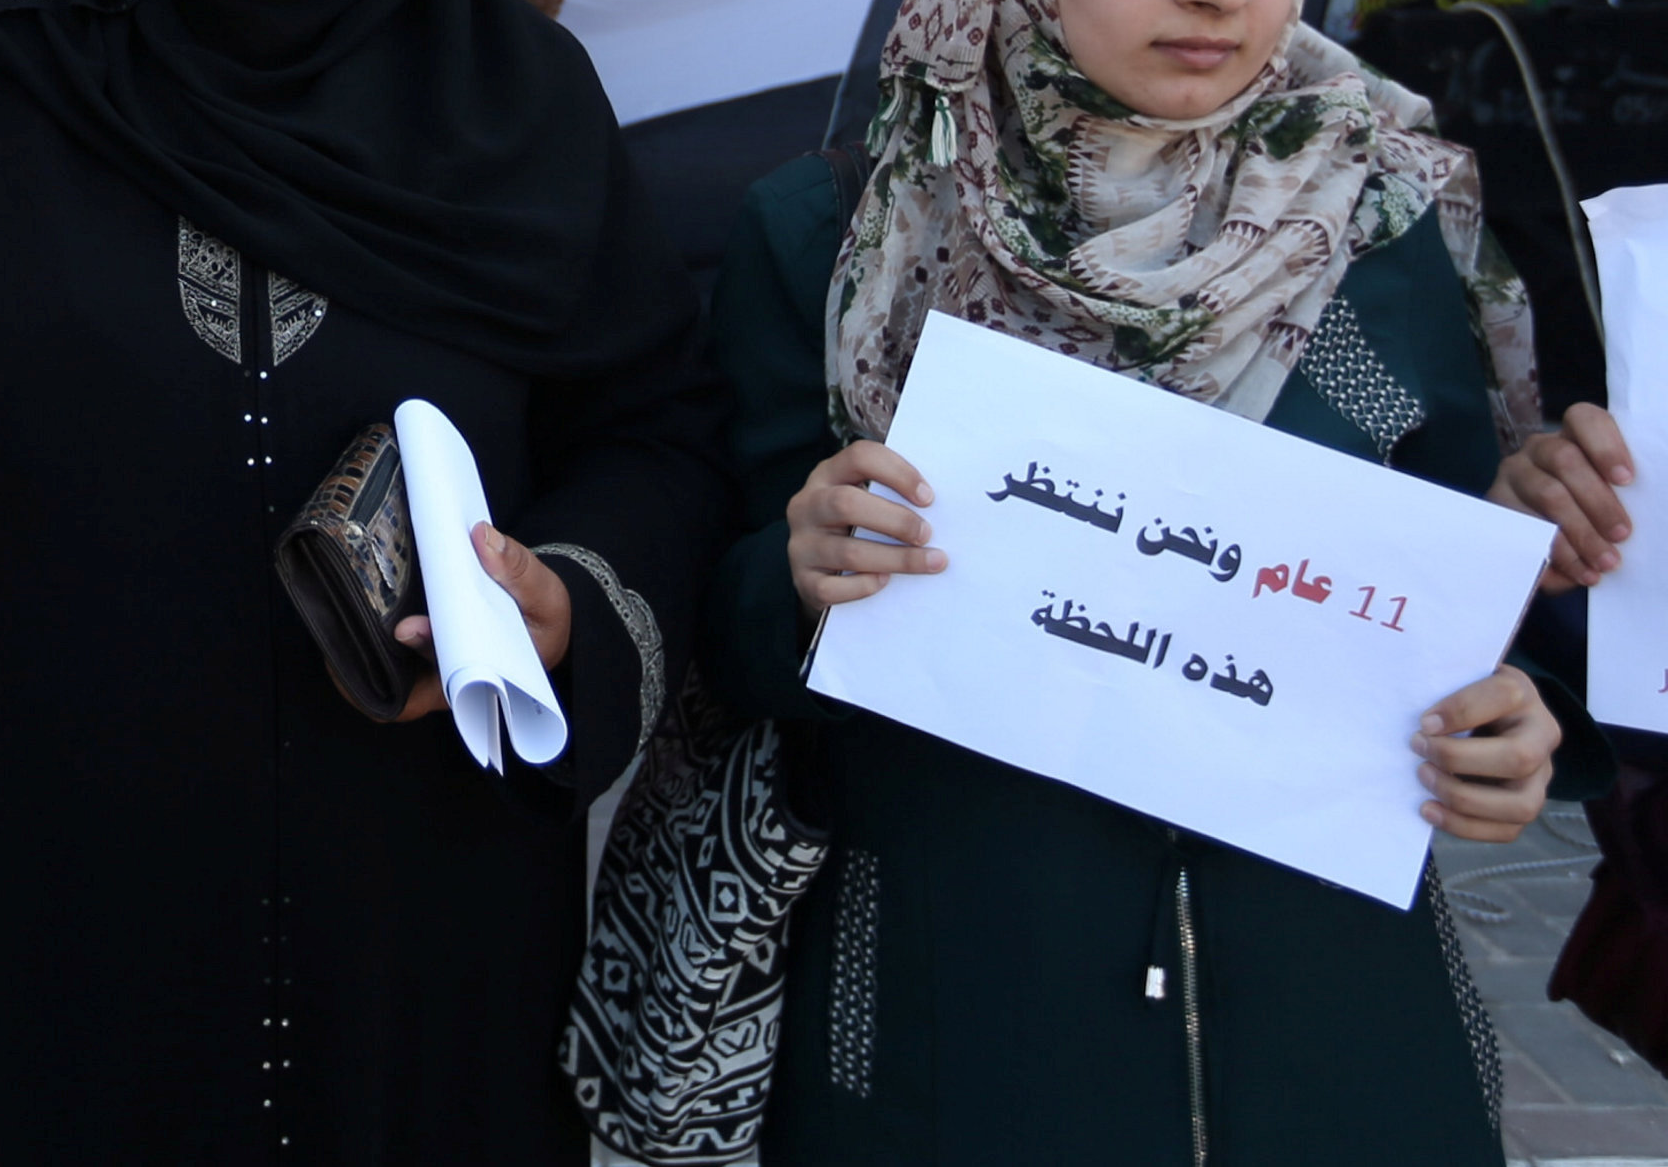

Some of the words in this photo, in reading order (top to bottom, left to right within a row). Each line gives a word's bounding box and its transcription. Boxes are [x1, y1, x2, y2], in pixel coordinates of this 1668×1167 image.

[984, 460, 1127, 534] ننتظر
[1135, 516, 1242, 583] ونحن
[1252, 558, 1333, 605] عام
[1348, 585, 1408, 633] 11
[1029, 589, 1173, 670] اللحظة
[1181, 652, 1275, 707] هذه
